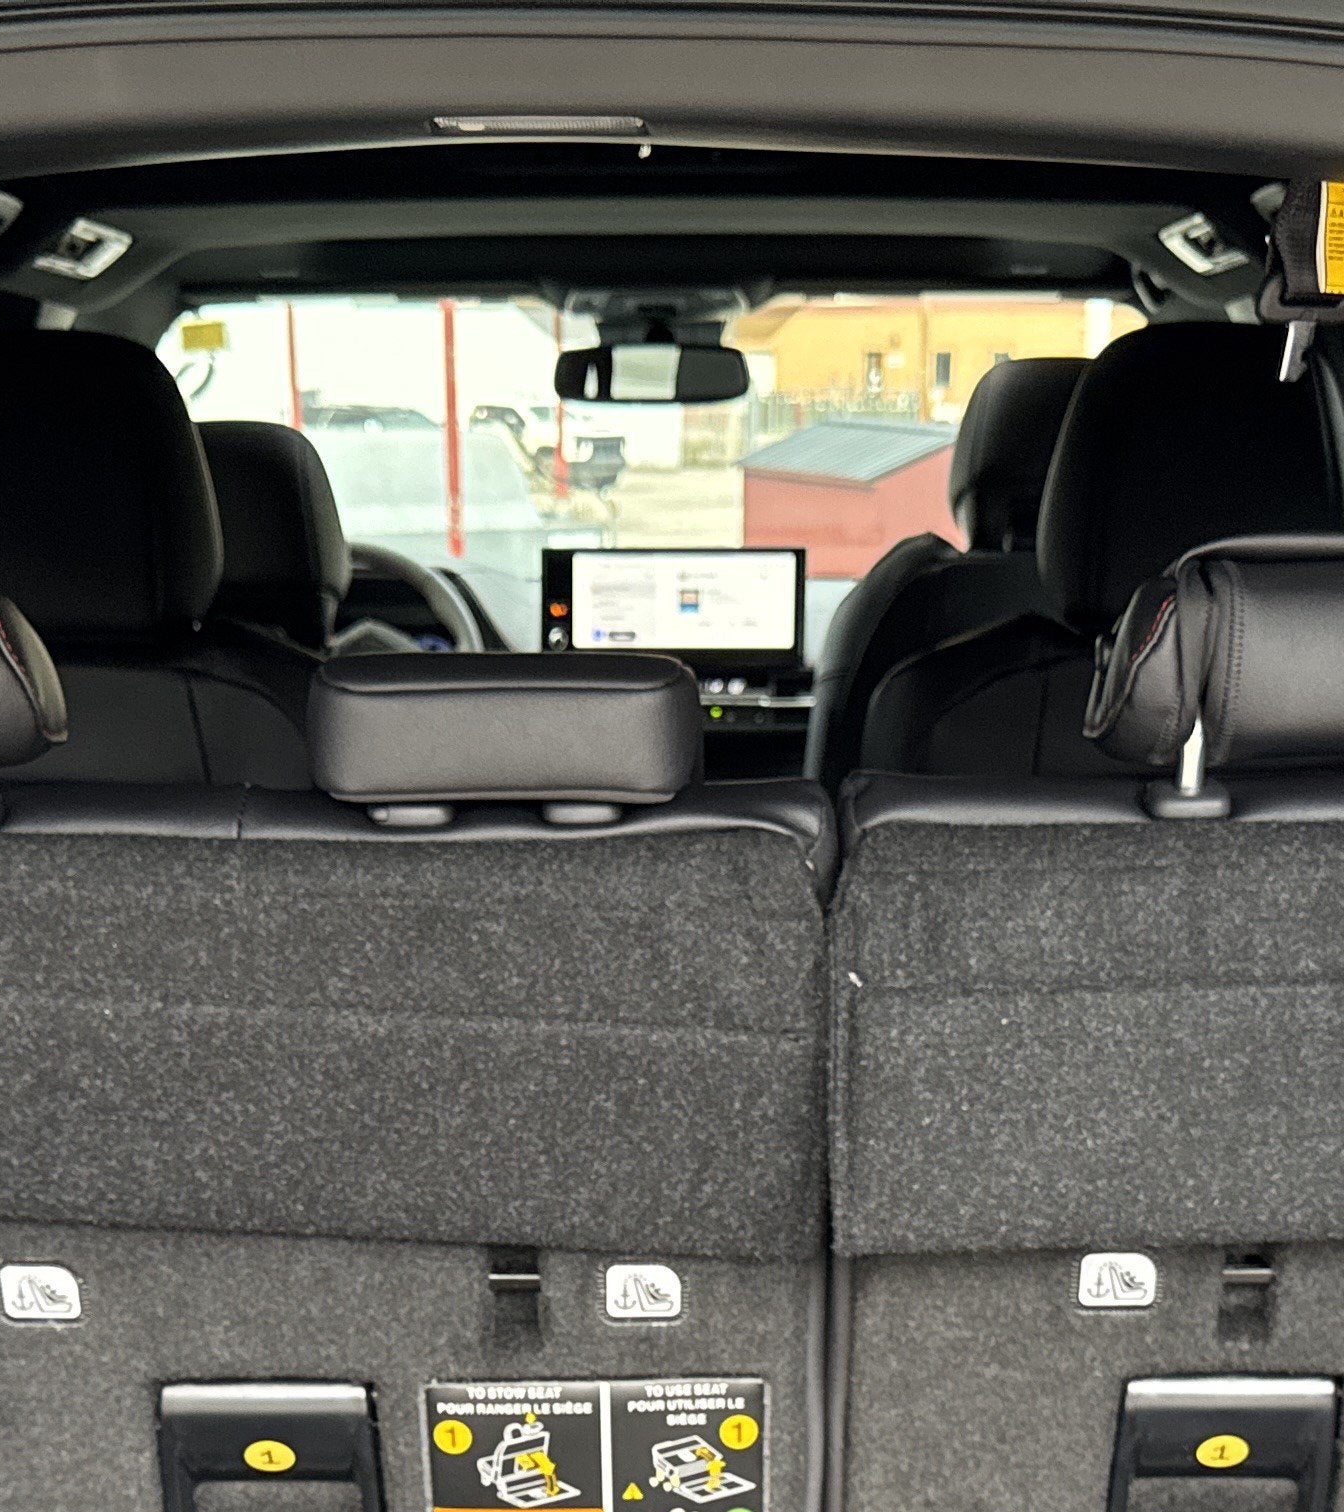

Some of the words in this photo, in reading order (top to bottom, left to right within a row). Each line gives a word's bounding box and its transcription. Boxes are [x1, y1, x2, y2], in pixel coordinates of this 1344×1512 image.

[466, 1387, 486, 1399] TO
[487, 1387, 527, 1399] STOW
[528, 1387, 562, 1399] SEAT
[644, 1384, 664, 1397] TO
[665, 1384, 692, 1397] USE
[693, 1383, 728, 1396] SEAT
[436, 1402, 475, 1414] POUR
[476, 1403, 531, 1415] RANGER
[533, 1403, 550, 1415] LE
[627, 1400, 665, 1412] POUR
[666, 1398, 726, 1411] UTILISER
[727, 1397, 745, 1409] LE
[445, 1424, 456, 1448] 1
[732, 1422, 743, 1443] 1
[260, 1450, 281, 1465] 1
[1210, 1444, 1230, 1461] 1
